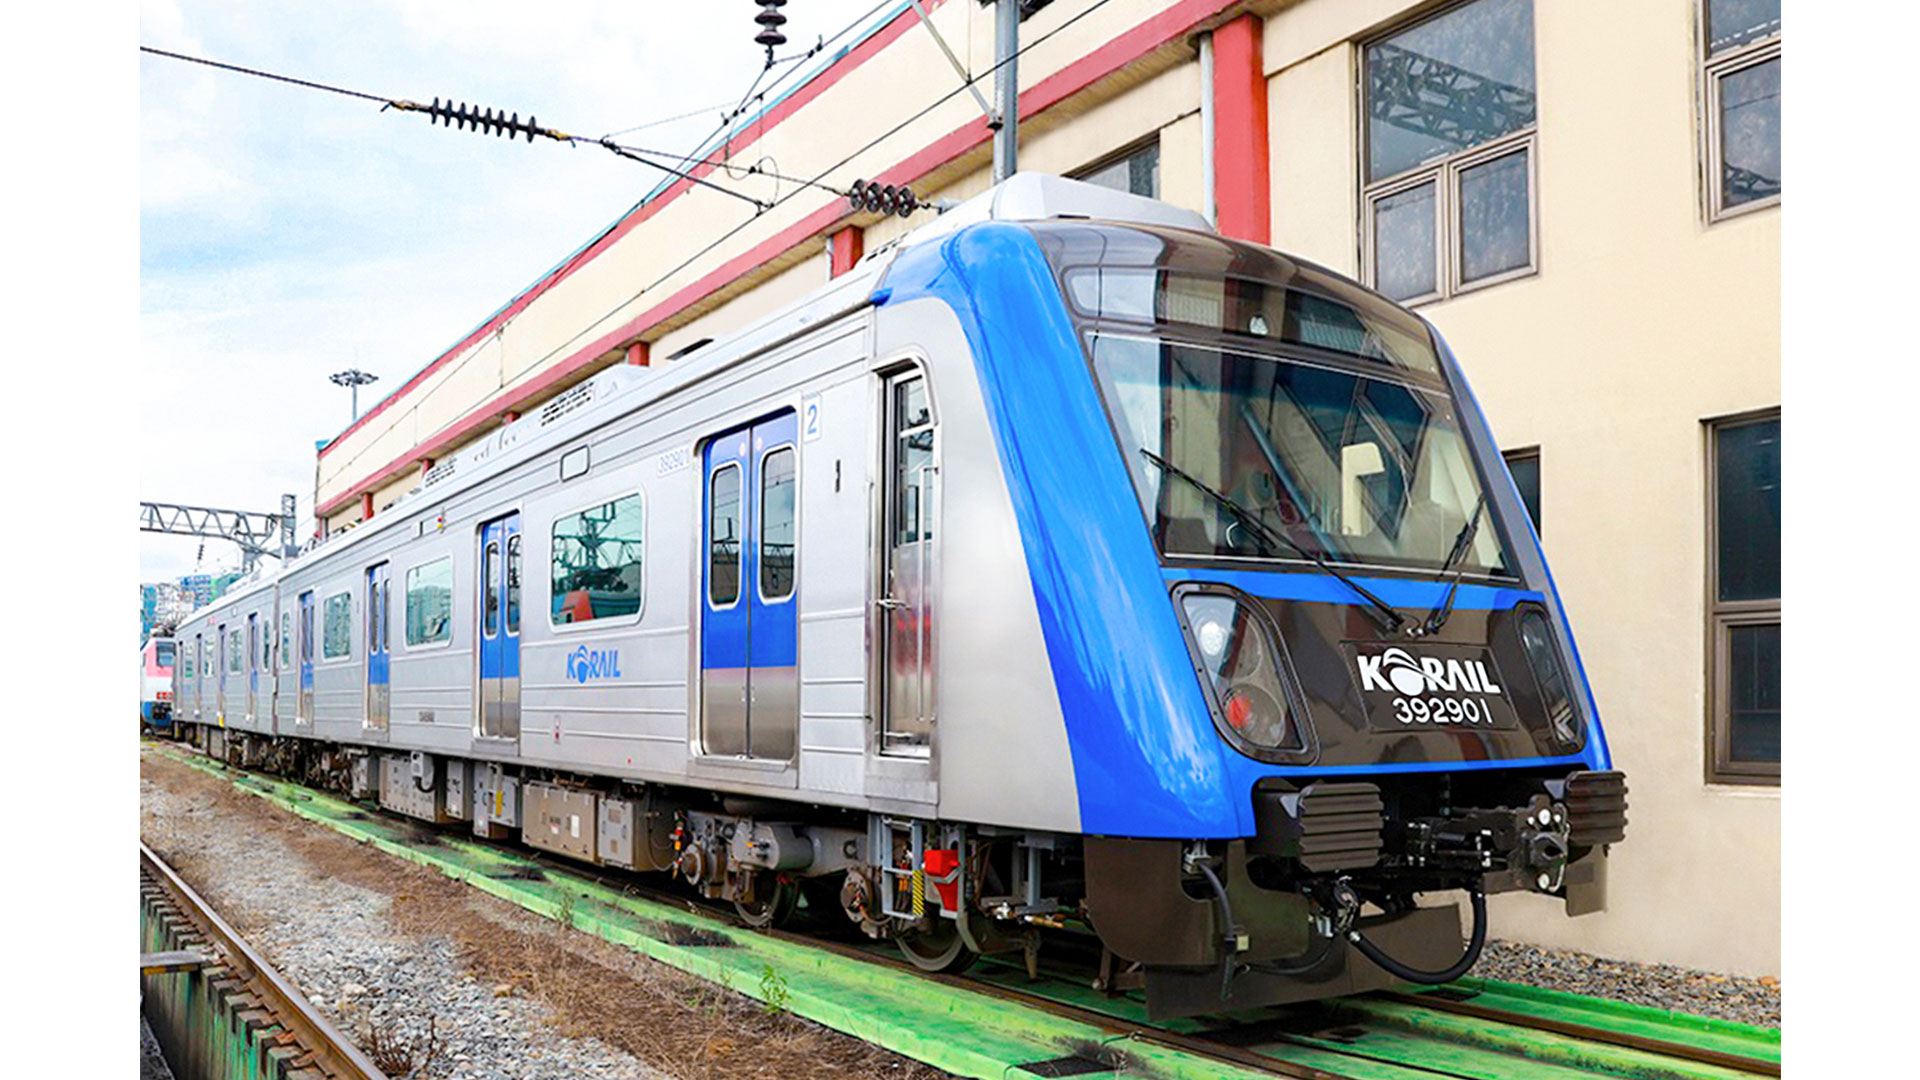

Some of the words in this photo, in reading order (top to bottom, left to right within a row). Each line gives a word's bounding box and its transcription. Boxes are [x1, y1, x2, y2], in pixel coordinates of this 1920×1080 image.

[807, 404, 817, 435] 2
[566, 644, 621, 684] KORAIL
[1356, 647, 1501, 696] KORAIL
[1392, 697, 1493, 725] 392901
